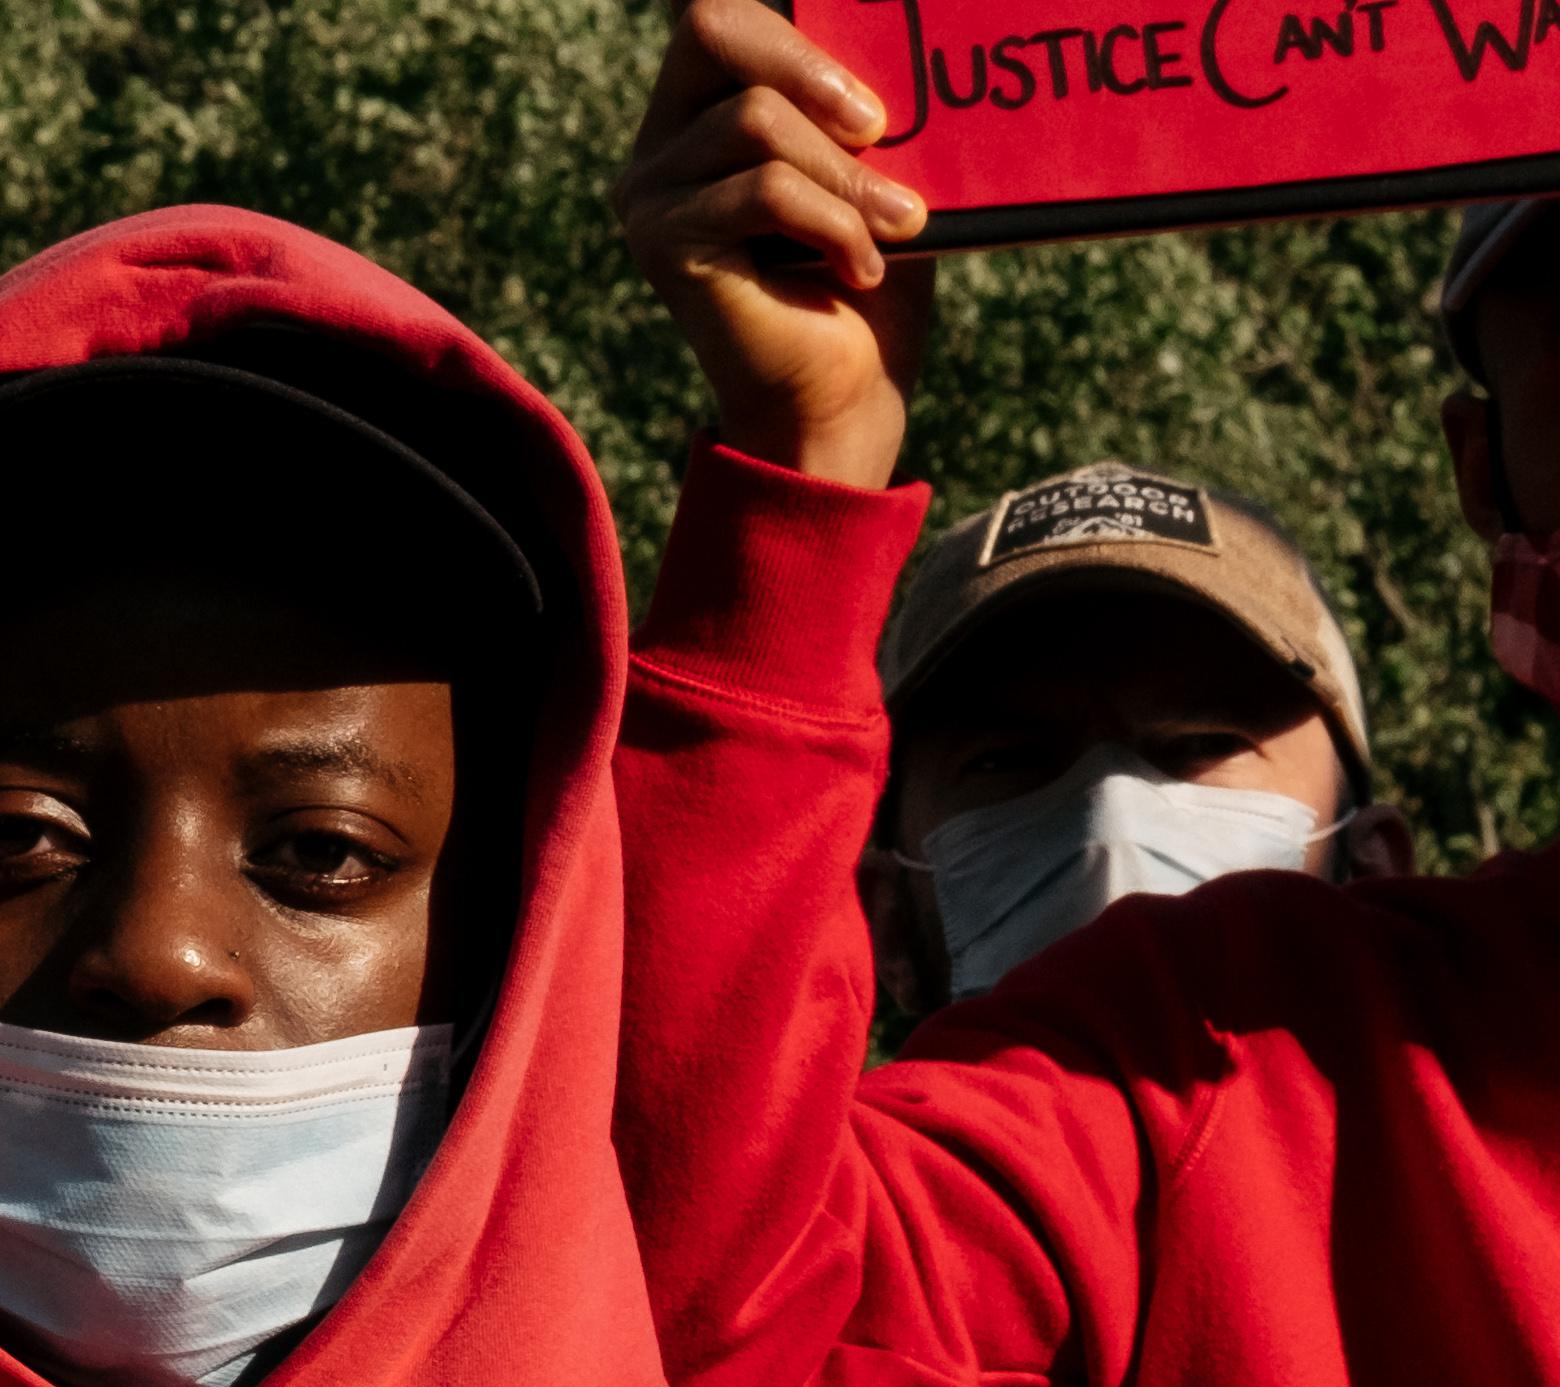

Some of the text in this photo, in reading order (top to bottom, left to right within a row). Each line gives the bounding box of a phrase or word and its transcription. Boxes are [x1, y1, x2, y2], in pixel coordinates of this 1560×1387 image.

[860, 0, 1193, 148] JUSTICE
[1006, 493, 1196, 535] RESEARCH
[1013, 482, 1189, 517] OUTDOOR
